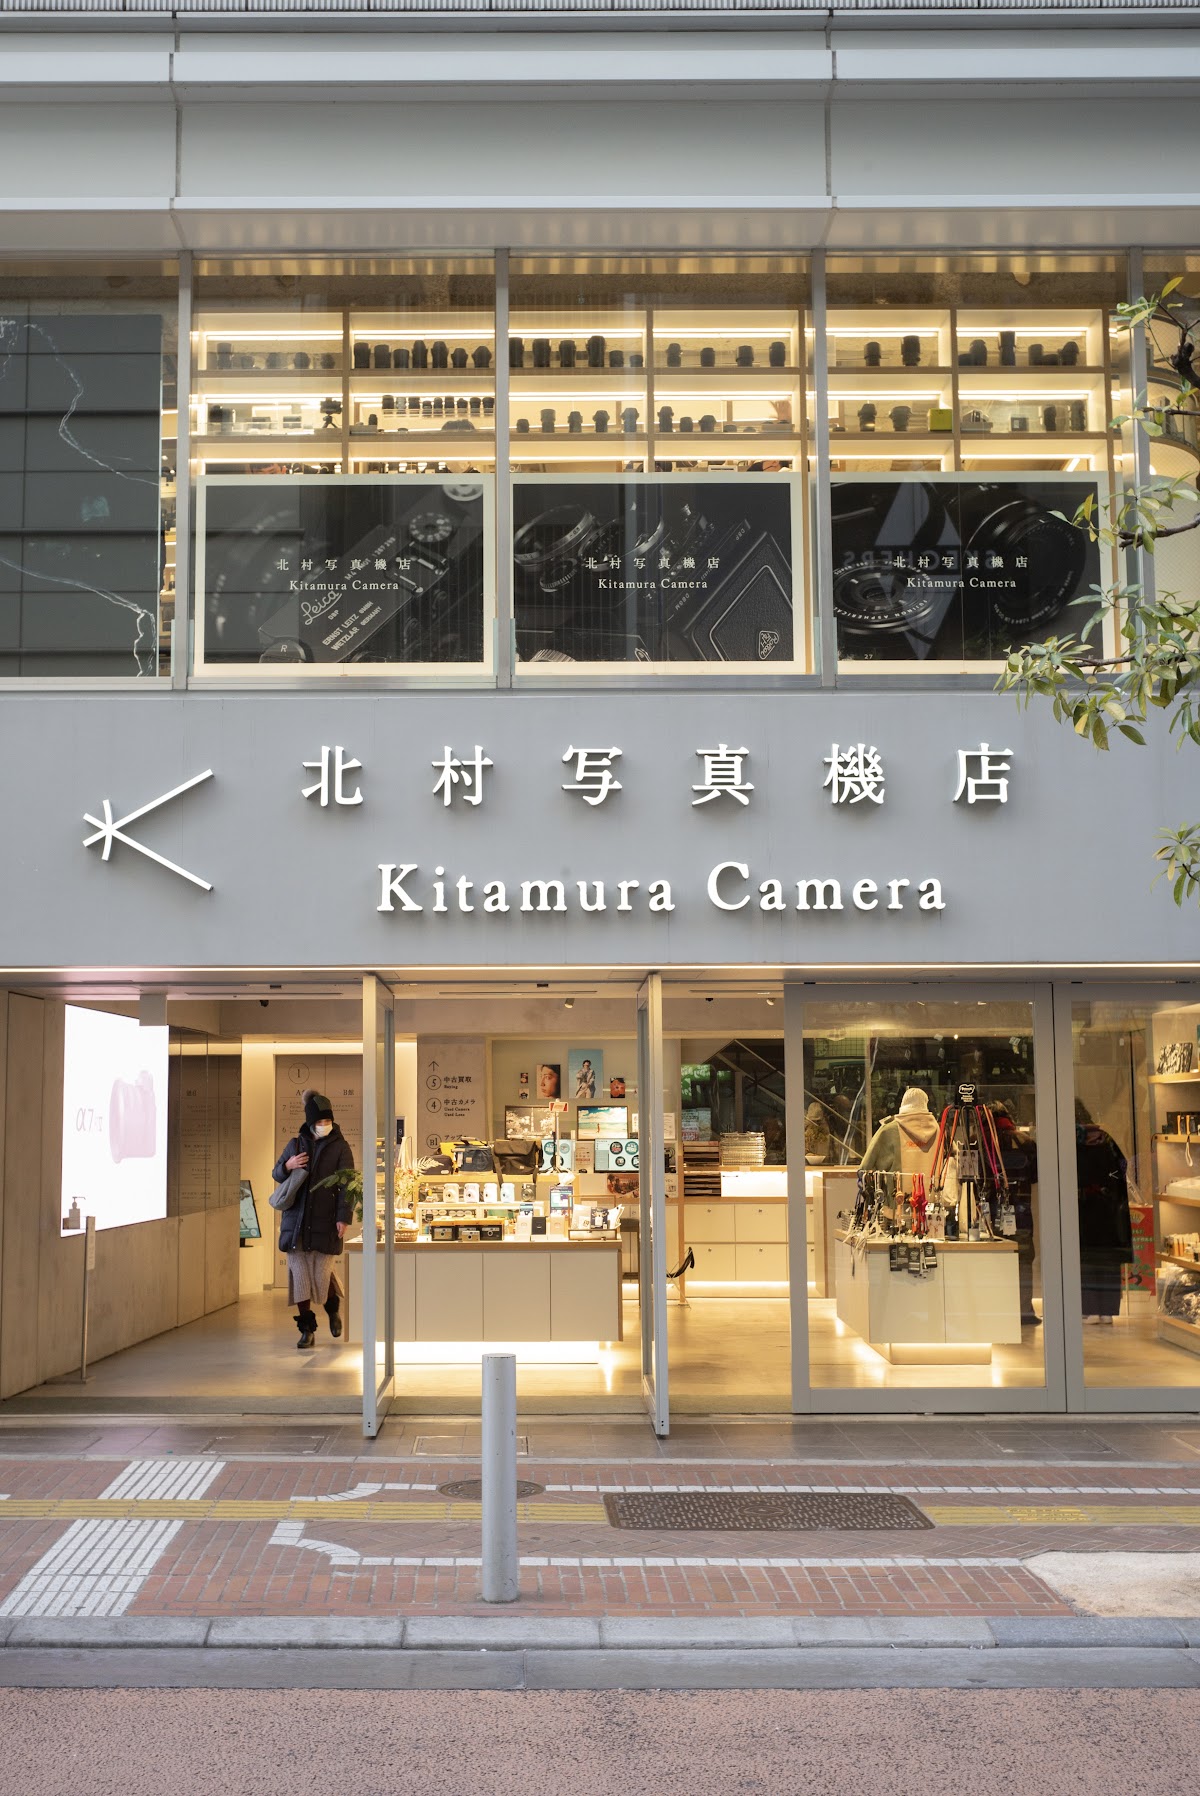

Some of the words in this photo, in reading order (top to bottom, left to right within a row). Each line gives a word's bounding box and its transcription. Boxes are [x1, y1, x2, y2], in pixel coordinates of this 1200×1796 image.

[276, 559, 411, 571] 北村写真機店
[585, 557, 720, 569] 北村写真機店
[893, 556, 1028, 568] 北村写真機店
[289, 580, 347, 590] Kitamura
[352, 580, 399, 590] Camera
[598, 579, 656, 589] Kitamura
[661, 578, 708, 588] Camera
[907, 578, 965, 588] Kitamura
[970, 577, 1017, 588] Camera
[301, 590, 342, 625] Leica
[322, 627, 344, 646] ERNST
[341, 613, 360, 629] LEITZ
[330, 626, 360, 651] WETZLAR
[360, 606, 382, 626] GERMANY
[301, 743, 1014, 807] 北村写真機店
[377, 863, 676, 912] Kitamura
[707, 861, 946, 911] Camera
[431, 1078, 437, 1088] 5
[431, 1101, 437, 1110] 4
[429, 1137, 438, 1146] B1
